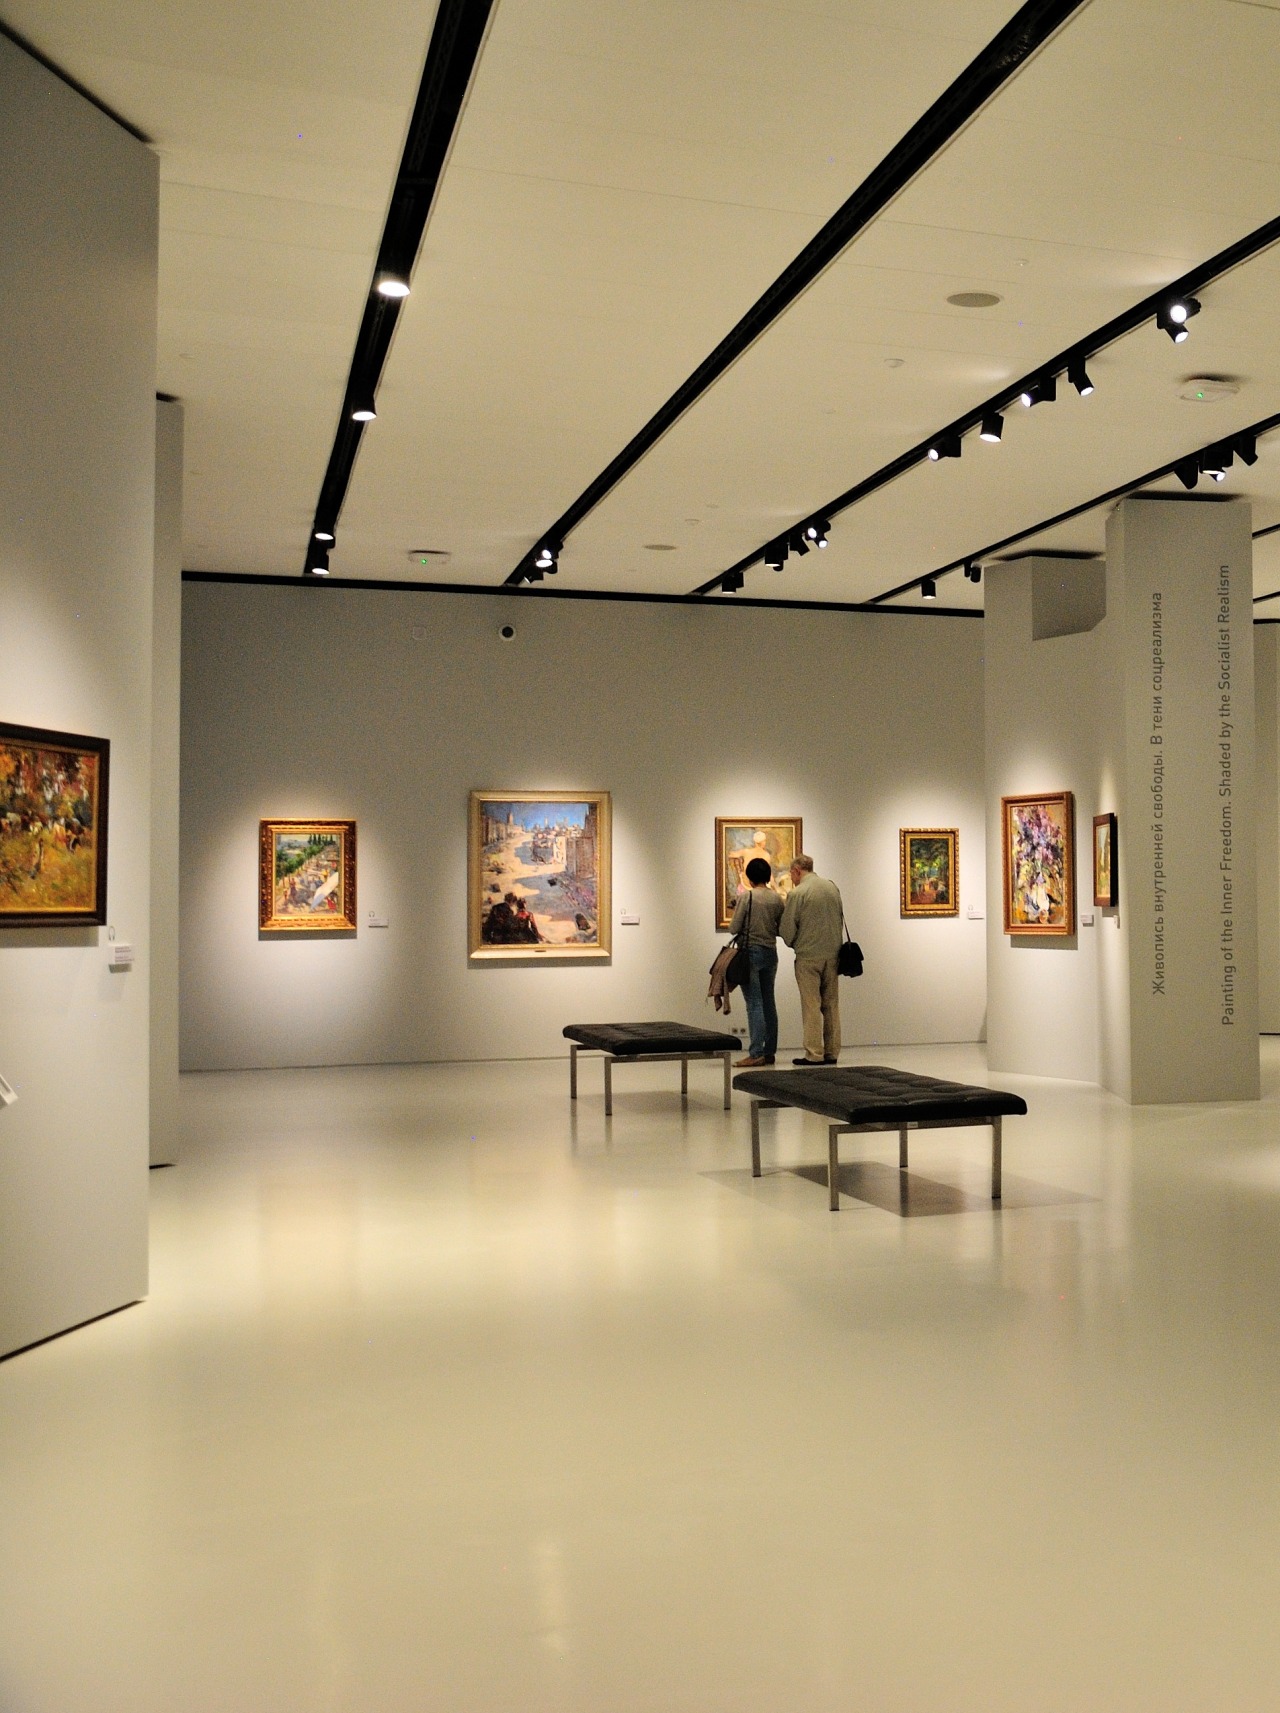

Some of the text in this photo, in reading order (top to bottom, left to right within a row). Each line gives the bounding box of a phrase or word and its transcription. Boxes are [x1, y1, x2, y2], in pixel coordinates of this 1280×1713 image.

[1150, 592, 1166, 995] Живопись внутренней свободы. В тени соцреализма
[1217, 565, 1236, 1026] Painting of the Inner Freedom. Shaded by the Socialist Realism
